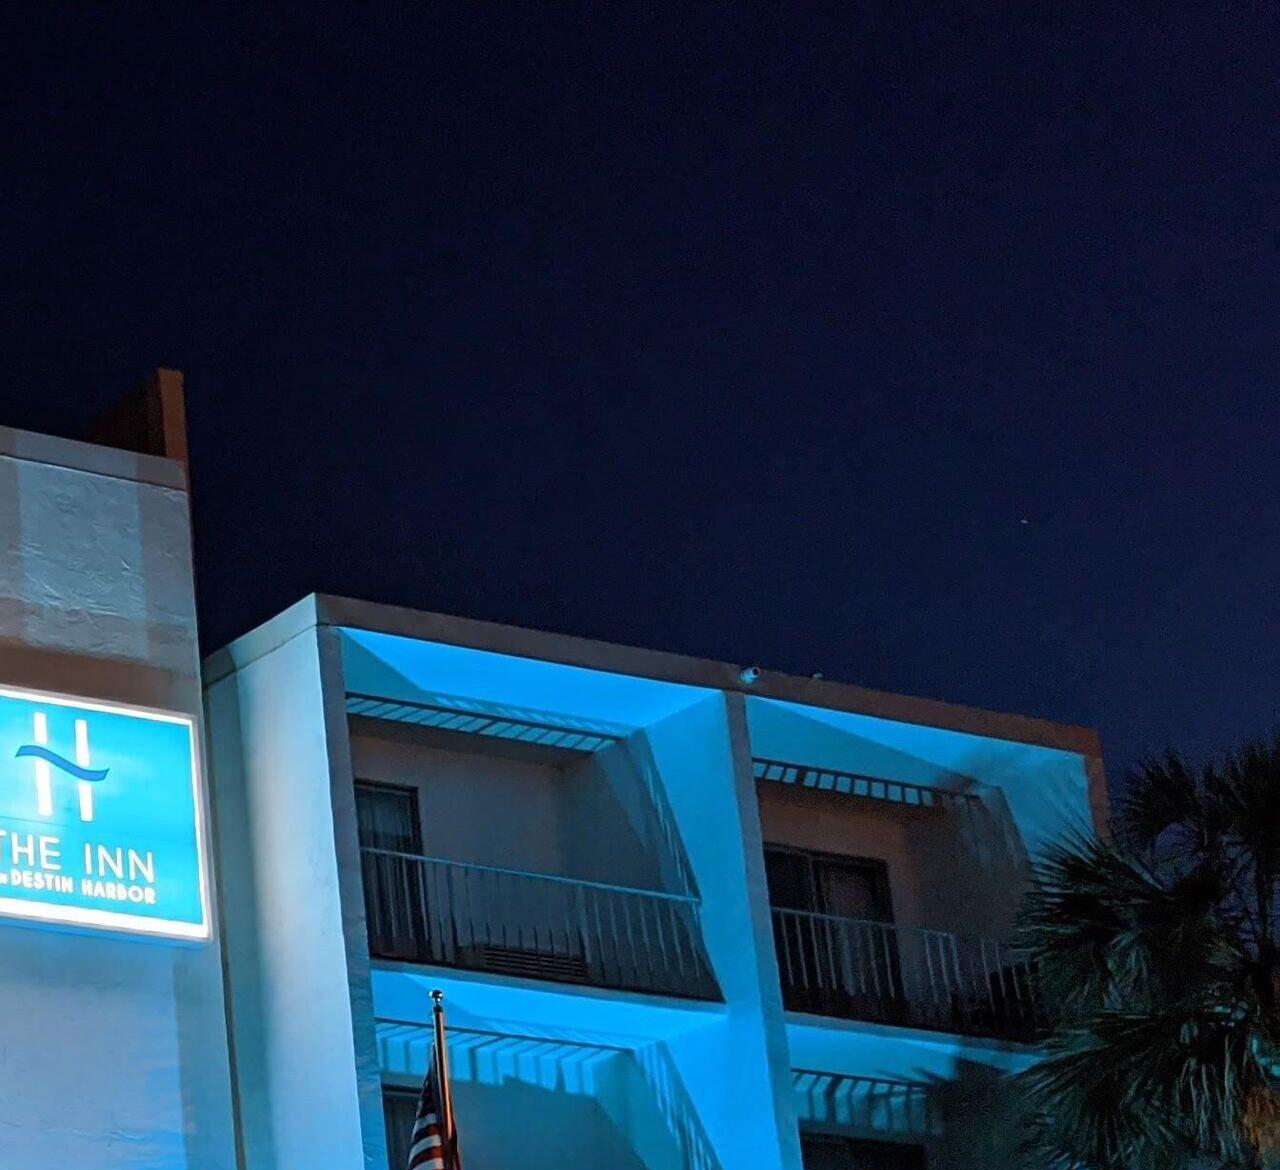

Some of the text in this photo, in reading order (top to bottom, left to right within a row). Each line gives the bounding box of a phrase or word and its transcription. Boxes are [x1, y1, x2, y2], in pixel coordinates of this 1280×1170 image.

[83, 842, 155, 884] INN
[10, 868, 74, 894] DESTIN
[81, 878, 157, 905] HARBOR
